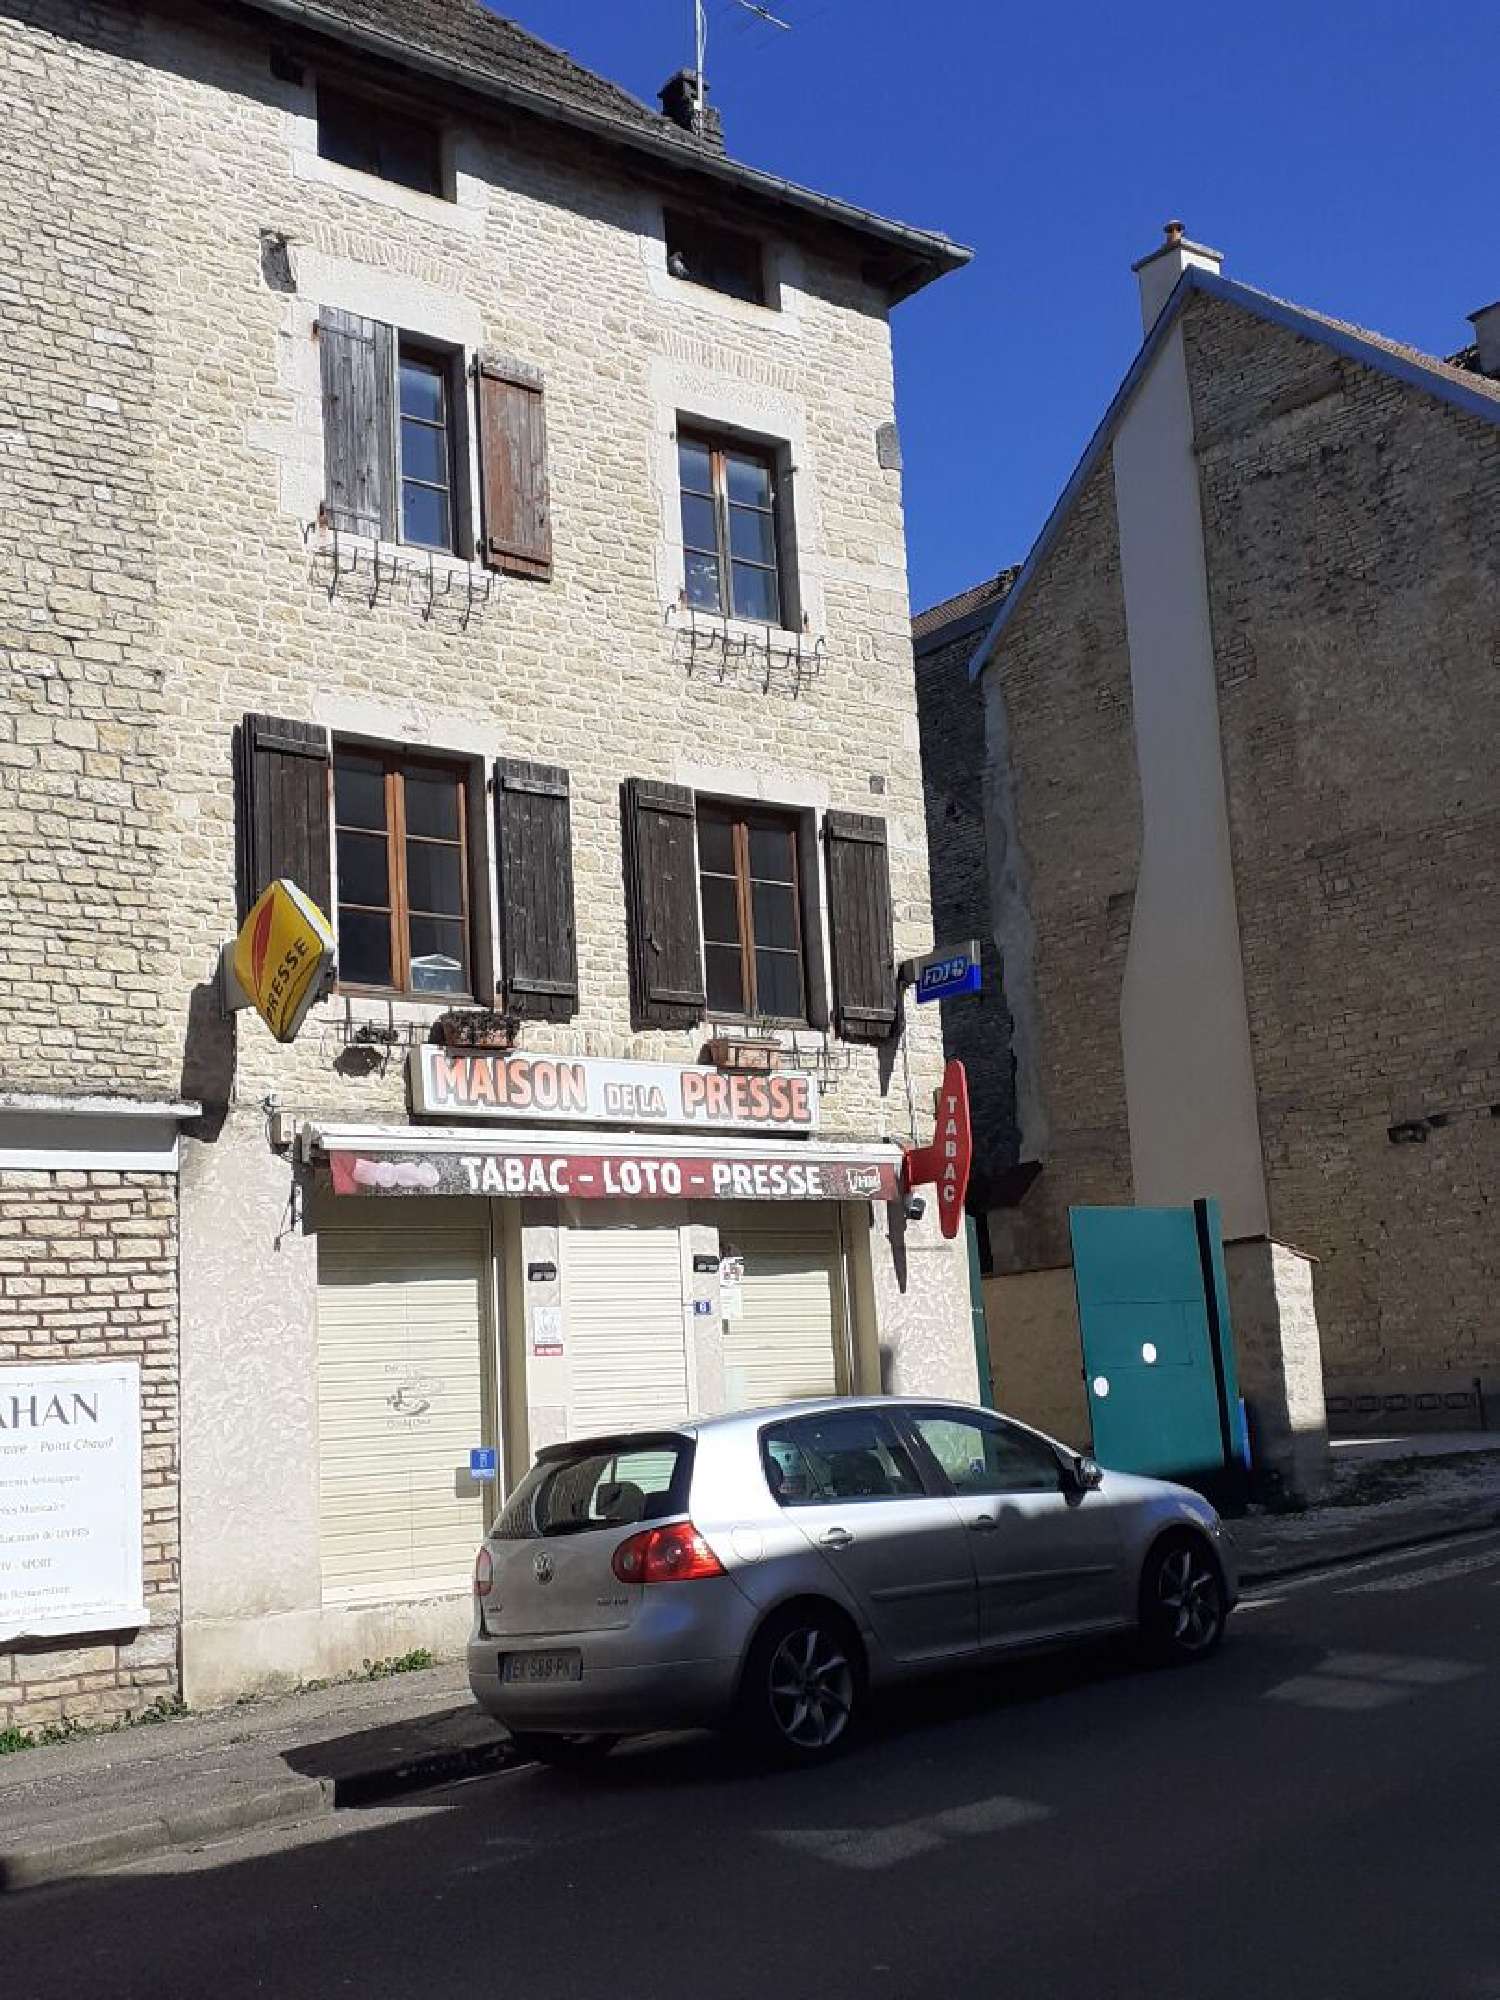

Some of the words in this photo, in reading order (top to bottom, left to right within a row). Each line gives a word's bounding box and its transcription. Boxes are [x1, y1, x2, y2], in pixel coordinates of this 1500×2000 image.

[923, 962, 951, 986] FDJ
[431, 1054, 588, 1111] MAISON
[680, 1071, 812, 1123] PRESSE
[460, 1157, 570, 1193] TABAC
[603, 1160, 682, 1195] LOTO
[713, 1164, 823, 1196] PRESSE
[944, 1096, 958, 1203] TABAC
